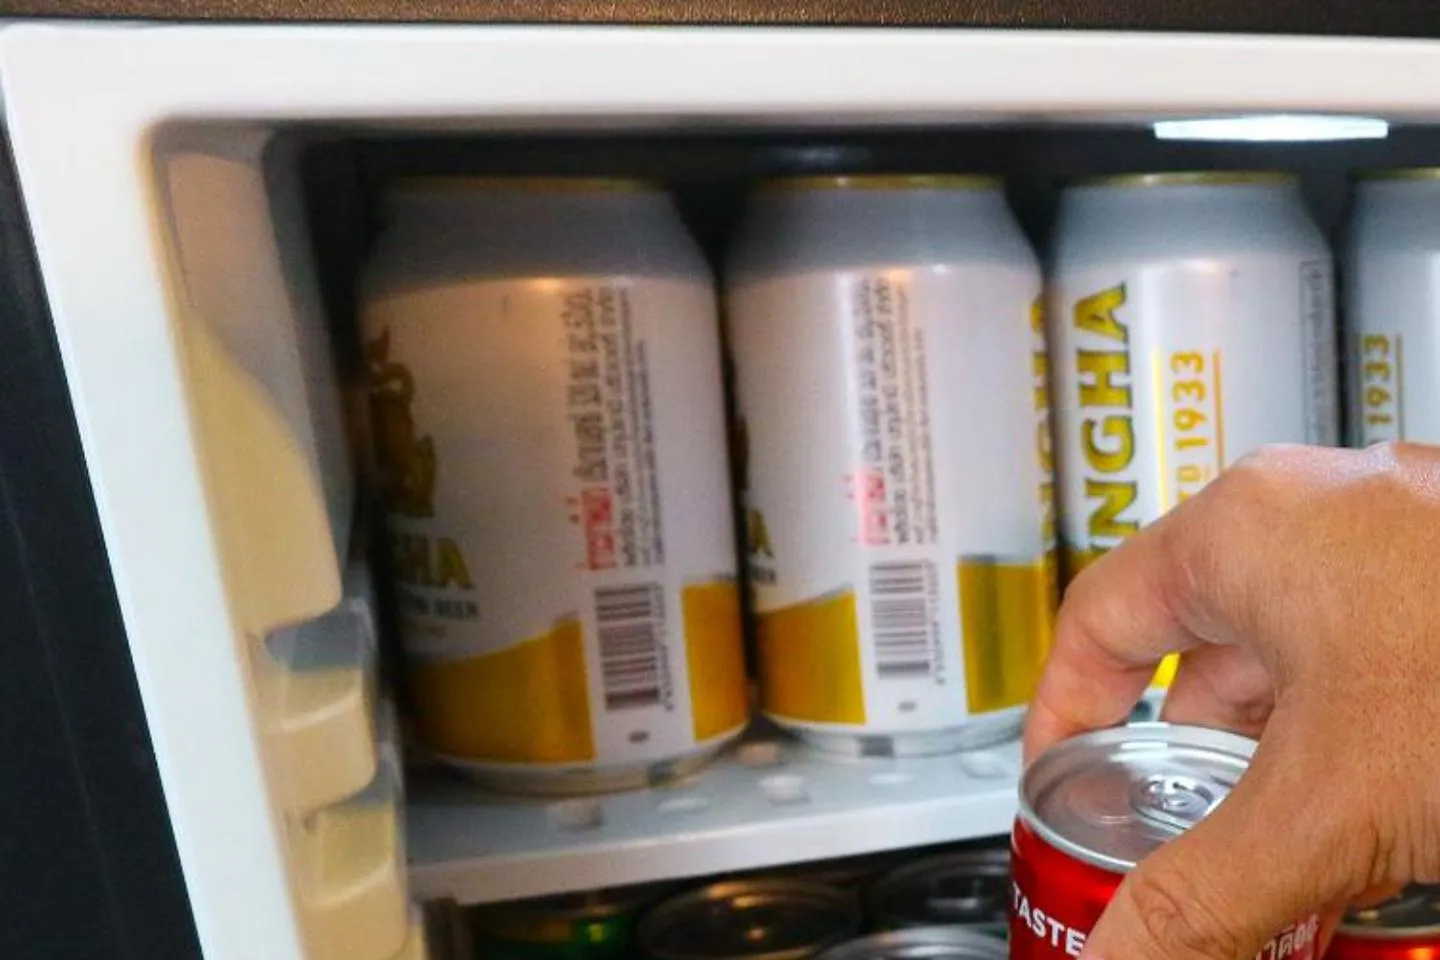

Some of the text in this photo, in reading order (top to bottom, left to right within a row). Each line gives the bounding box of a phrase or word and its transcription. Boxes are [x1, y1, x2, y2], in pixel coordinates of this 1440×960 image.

[1072, 282, 1141, 556] NGHA
[1170, 350, 1210, 452] 1933
[1011, 881, 1088, 957] TASTE
